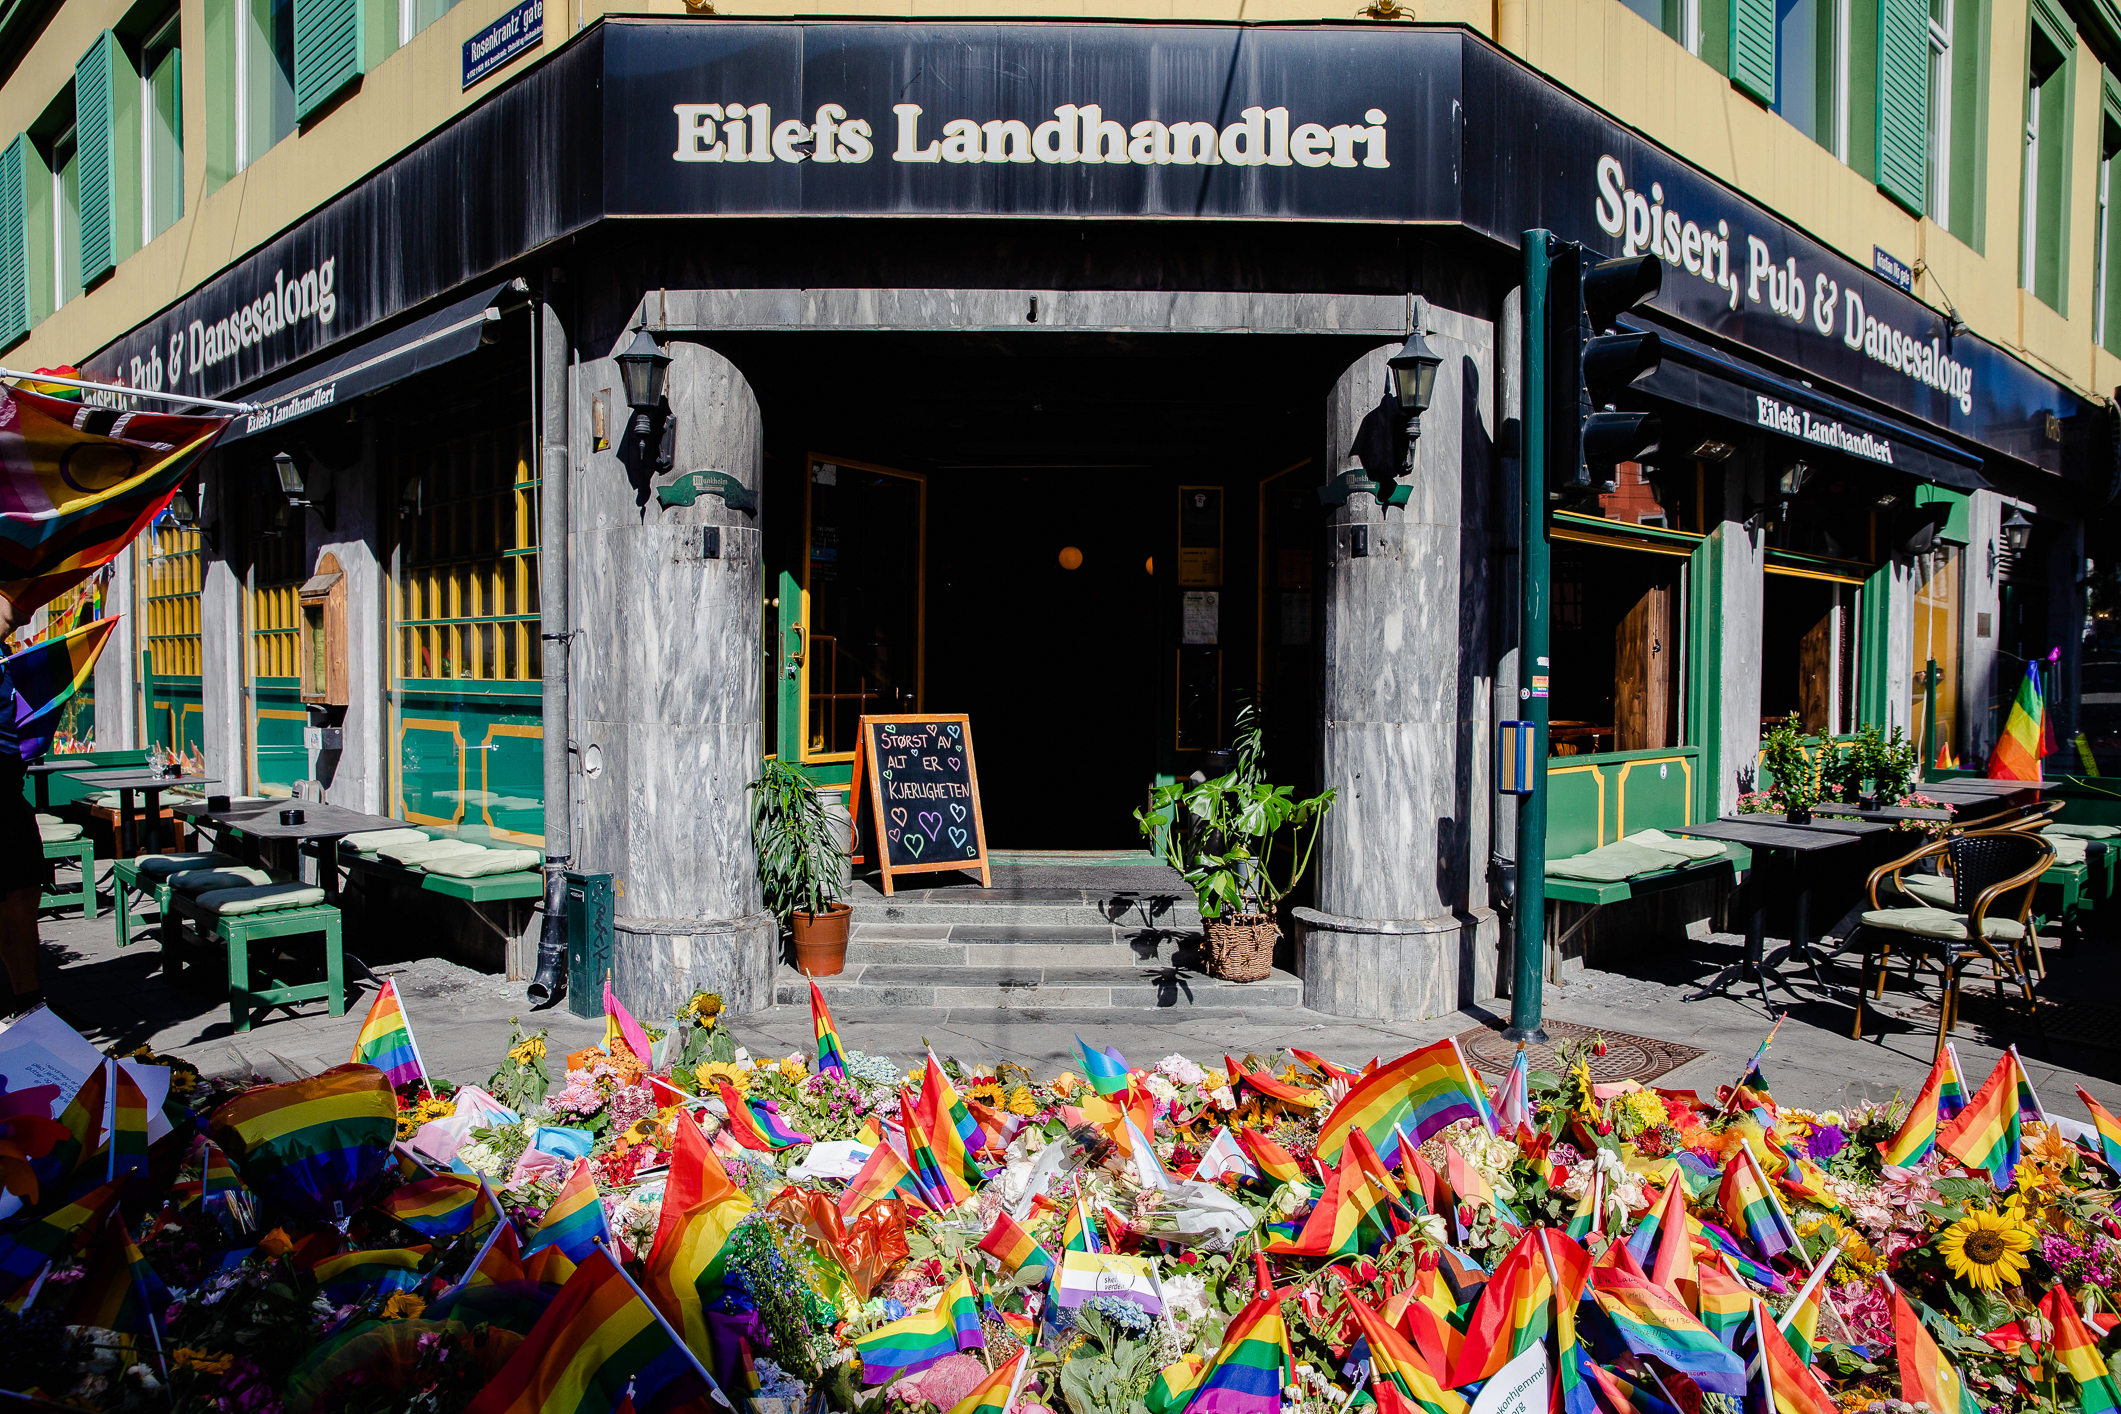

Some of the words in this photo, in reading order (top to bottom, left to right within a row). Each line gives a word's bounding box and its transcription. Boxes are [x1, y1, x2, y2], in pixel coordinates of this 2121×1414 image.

[471, 9, 522, 63] Rosenkrantz'
[523, 0, 543, 32] gate
[673, 103, 873, 163] Eilefs
[892, 103, 1391, 168] Landhandleri
[1596, 154, 1739, 310] Spiseri,
[1748, 234, 1806, 323] Pub
[1813, 272, 1838, 336] &
[1844, 287, 1972, 415] Dansesalong
[130, 345, 163, 405] Pub
[167, 330, 184, 386] &
[189, 255, 336, 376] Dansesalong
[271, 383, 336, 425] Landhandleri
[1756, 396, 1801, 436] Eilefs
[1803, 412, 1893, 464] Landhandleri
[882, 733, 928, 749] STØRST
[937, 735, 952, 750] AV
[887, 755, 908, 769] ALT
[922, 756, 943, 771] ER
[888, 781, 970, 801] KJÆRLIGHETEN
